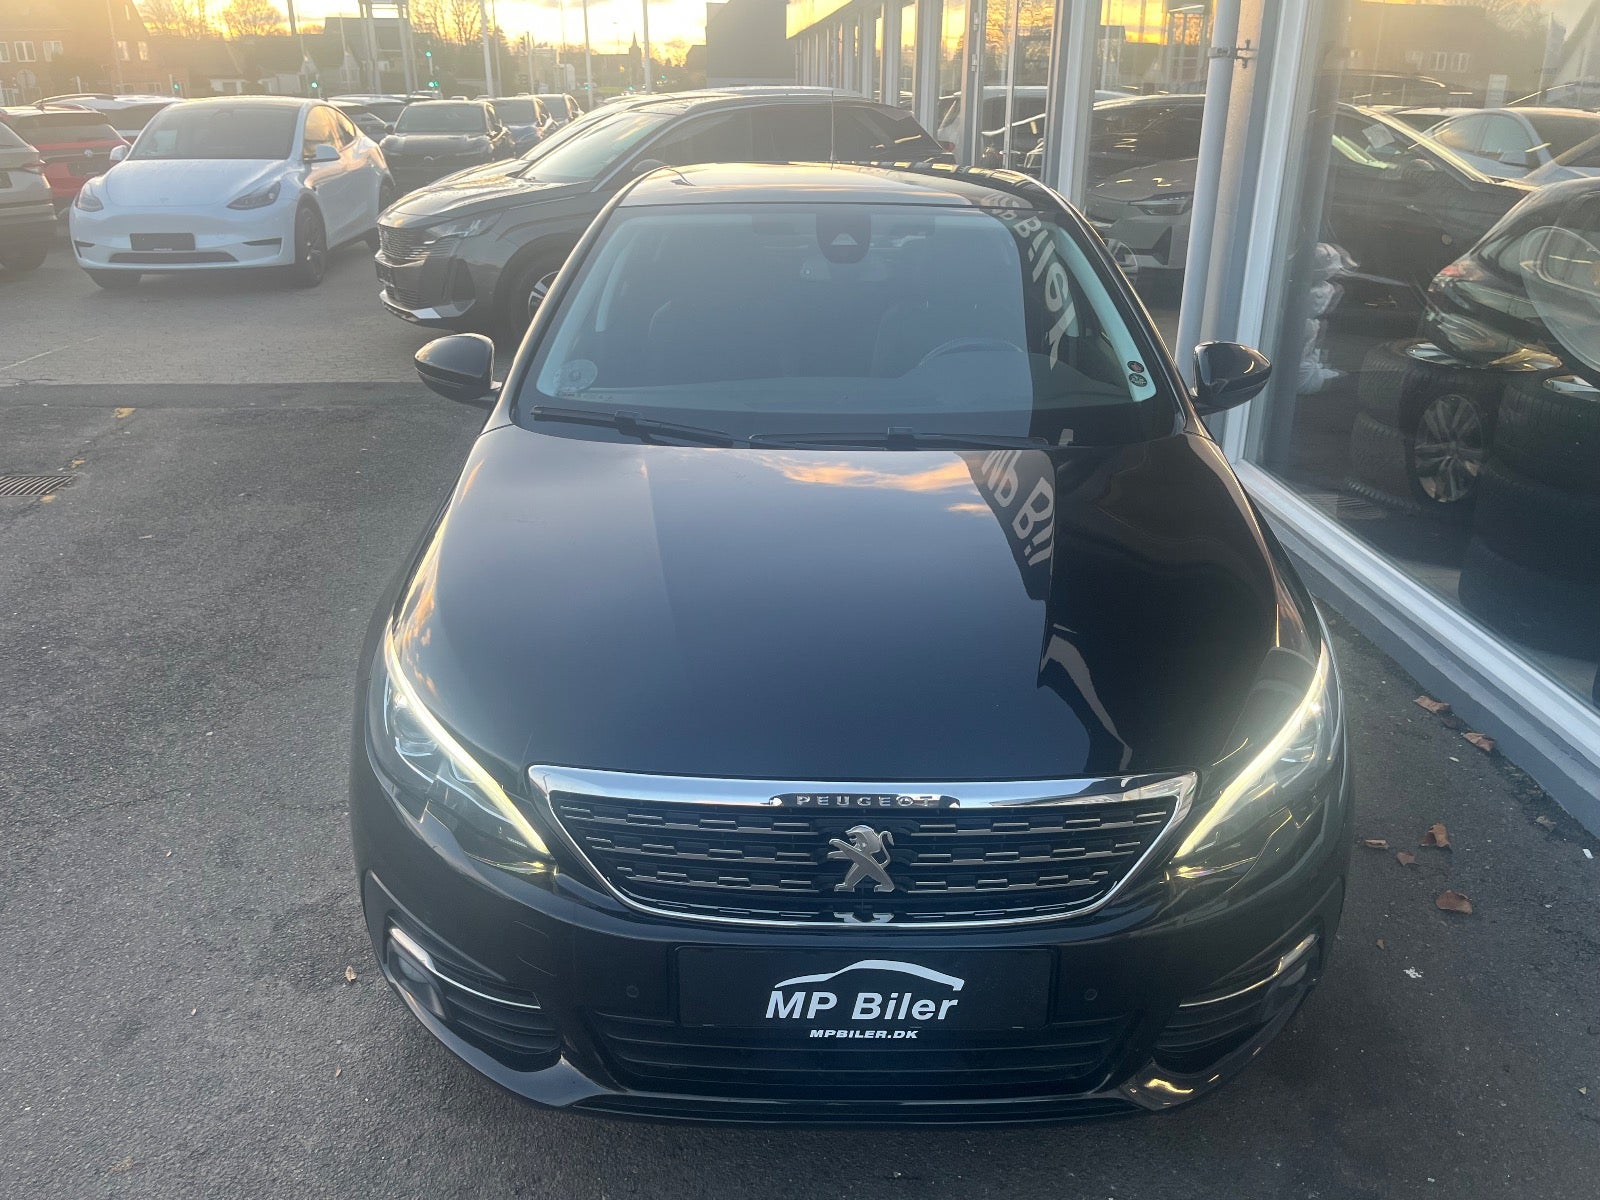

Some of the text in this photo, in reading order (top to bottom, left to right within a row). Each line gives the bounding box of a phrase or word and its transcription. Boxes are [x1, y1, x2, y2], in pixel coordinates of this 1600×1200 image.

[796, 795, 934, 807] PEUGEOT
[765, 990, 959, 1021] MP Biler
[809, 1029, 919, 1040] MPBILER.DK
